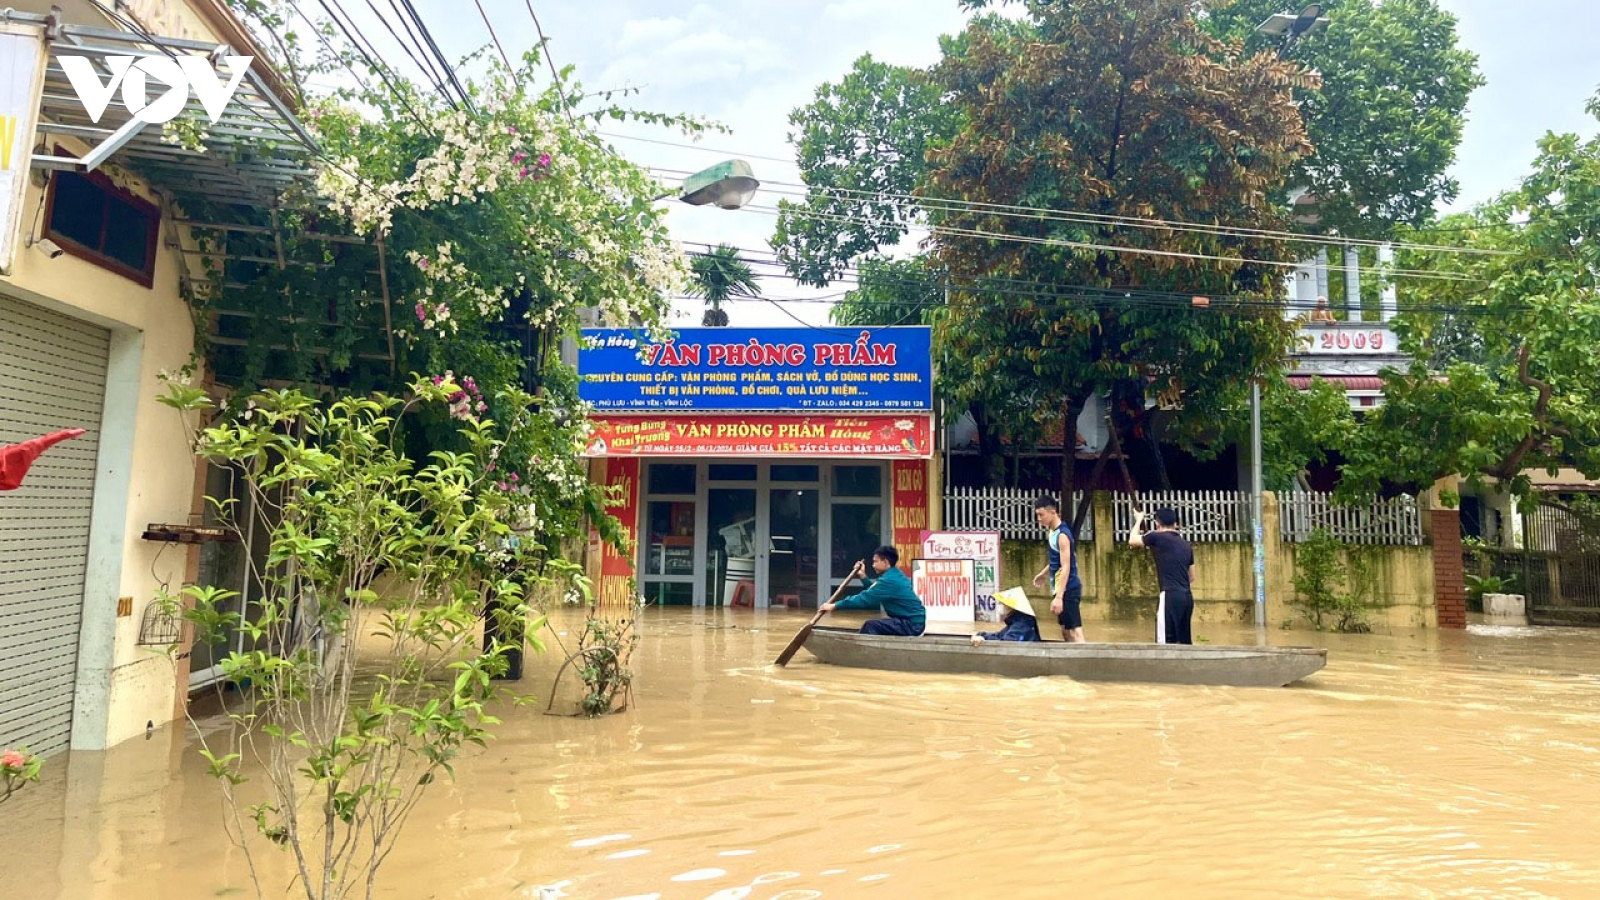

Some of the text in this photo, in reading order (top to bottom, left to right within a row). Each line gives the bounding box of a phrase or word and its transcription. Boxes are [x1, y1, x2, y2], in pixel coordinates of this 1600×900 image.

[607, 332, 637, 350] Hồng
[640, 330, 897, 366] VĂN PHÒNG PHẨM
[1320, 330, 1383, 349] 2009
[625, 372, 653, 383] CUNG
[655, 369, 678, 382] CẤP:
[681, 370, 702, 382] VĂN
[703, 370, 737, 382] PHÒNG
[741, 369, 774, 383] PHẨM,
[776, 370, 803, 382] SÁCH
[825, 369, 839, 382] ĐỒ
[840, 370, 868, 382] DÙNG
[870, 372, 890, 384] HỌC
[893, 372, 921, 383] SINH,
[640, 383, 868, 398] THIẾT BỊ VĂN PHÒNG, ĐỒ CHƠI, QUÀ LƯU NIỆM...
[676, 417, 826, 438] VĂN PHÒNG PHẨM
[736, 443, 757, 453] GIẢM
[759, 443, 775, 453] GIÁ
[776, 443, 798, 453] 15%
[799, 442, 816, 453] TẤT
[818, 442, 831, 453] CẢ
[832, 443, 852, 453] CÁC
[853, 444, 873, 454] MẶT
[875, 443, 901, 453] HÀNG
[975, 563, 995, 586] ỆN
[917, 576, 971, 607] PHOTOCOPPI
[977, 594, 996, 611] NG
